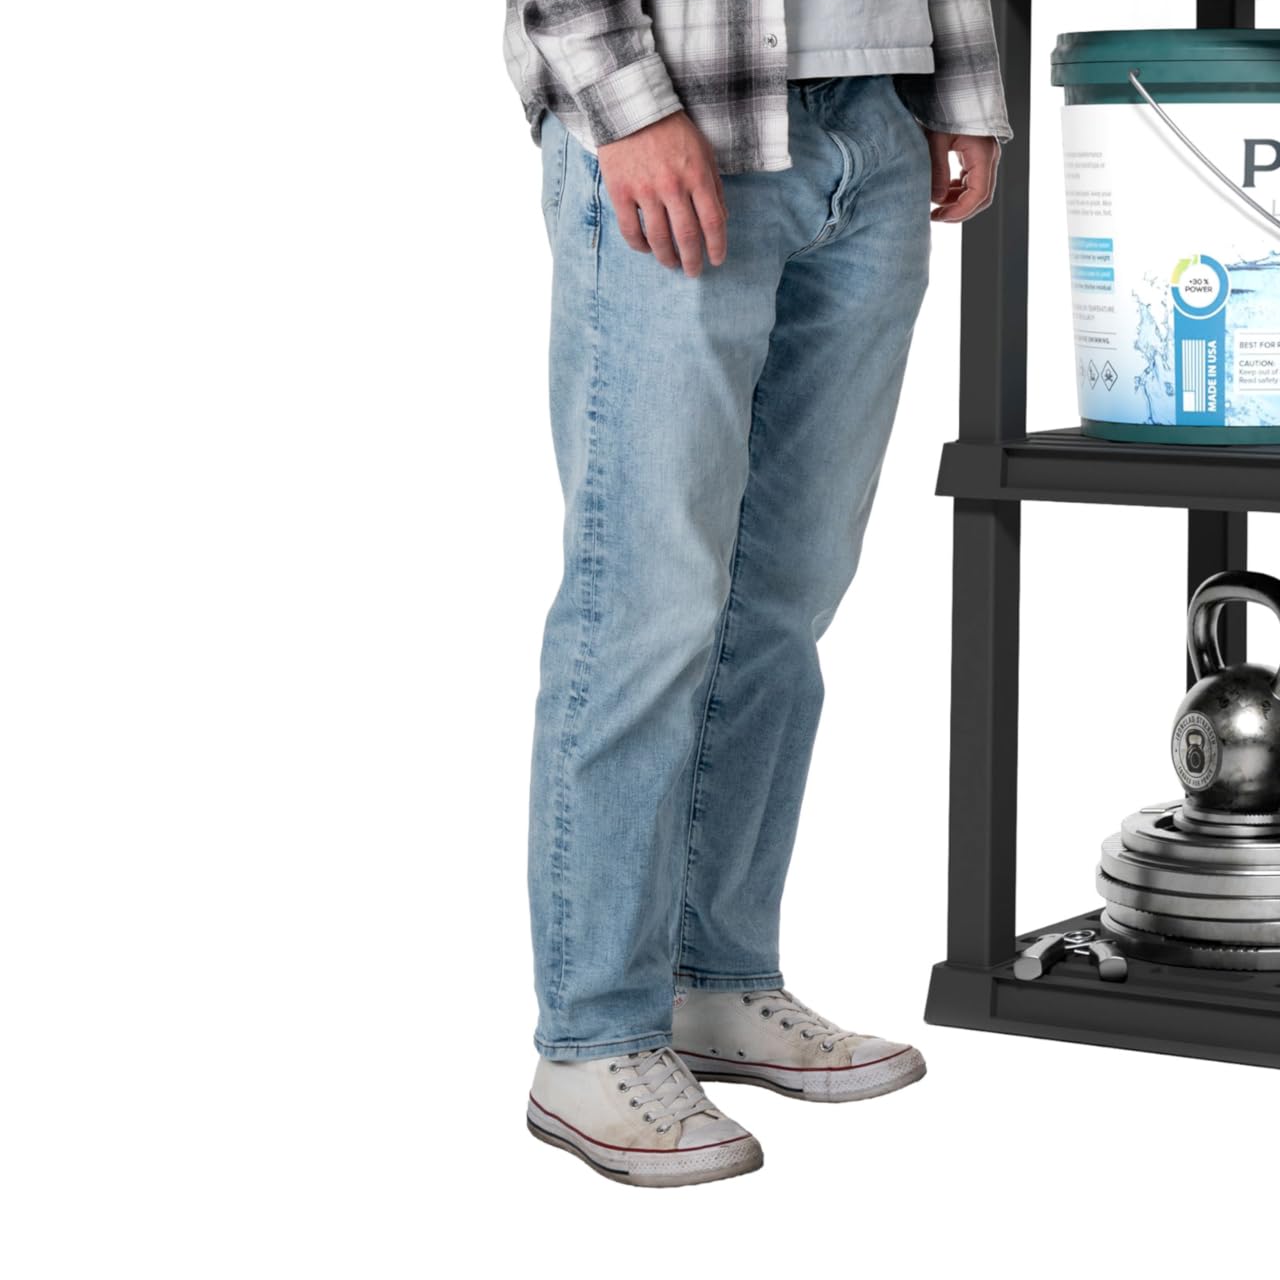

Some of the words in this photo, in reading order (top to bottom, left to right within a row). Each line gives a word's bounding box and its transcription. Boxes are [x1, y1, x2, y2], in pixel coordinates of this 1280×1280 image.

[1185, 285, 1213, 293] POWER
[1207, 340, 1217, 362] USA
[1207, 365, 1217, 379] IN
[1239, 368, 1256, 376] Keep
[1258, 376, 1278, 385] safety
[1207, 381, 1217, 412] MADE
